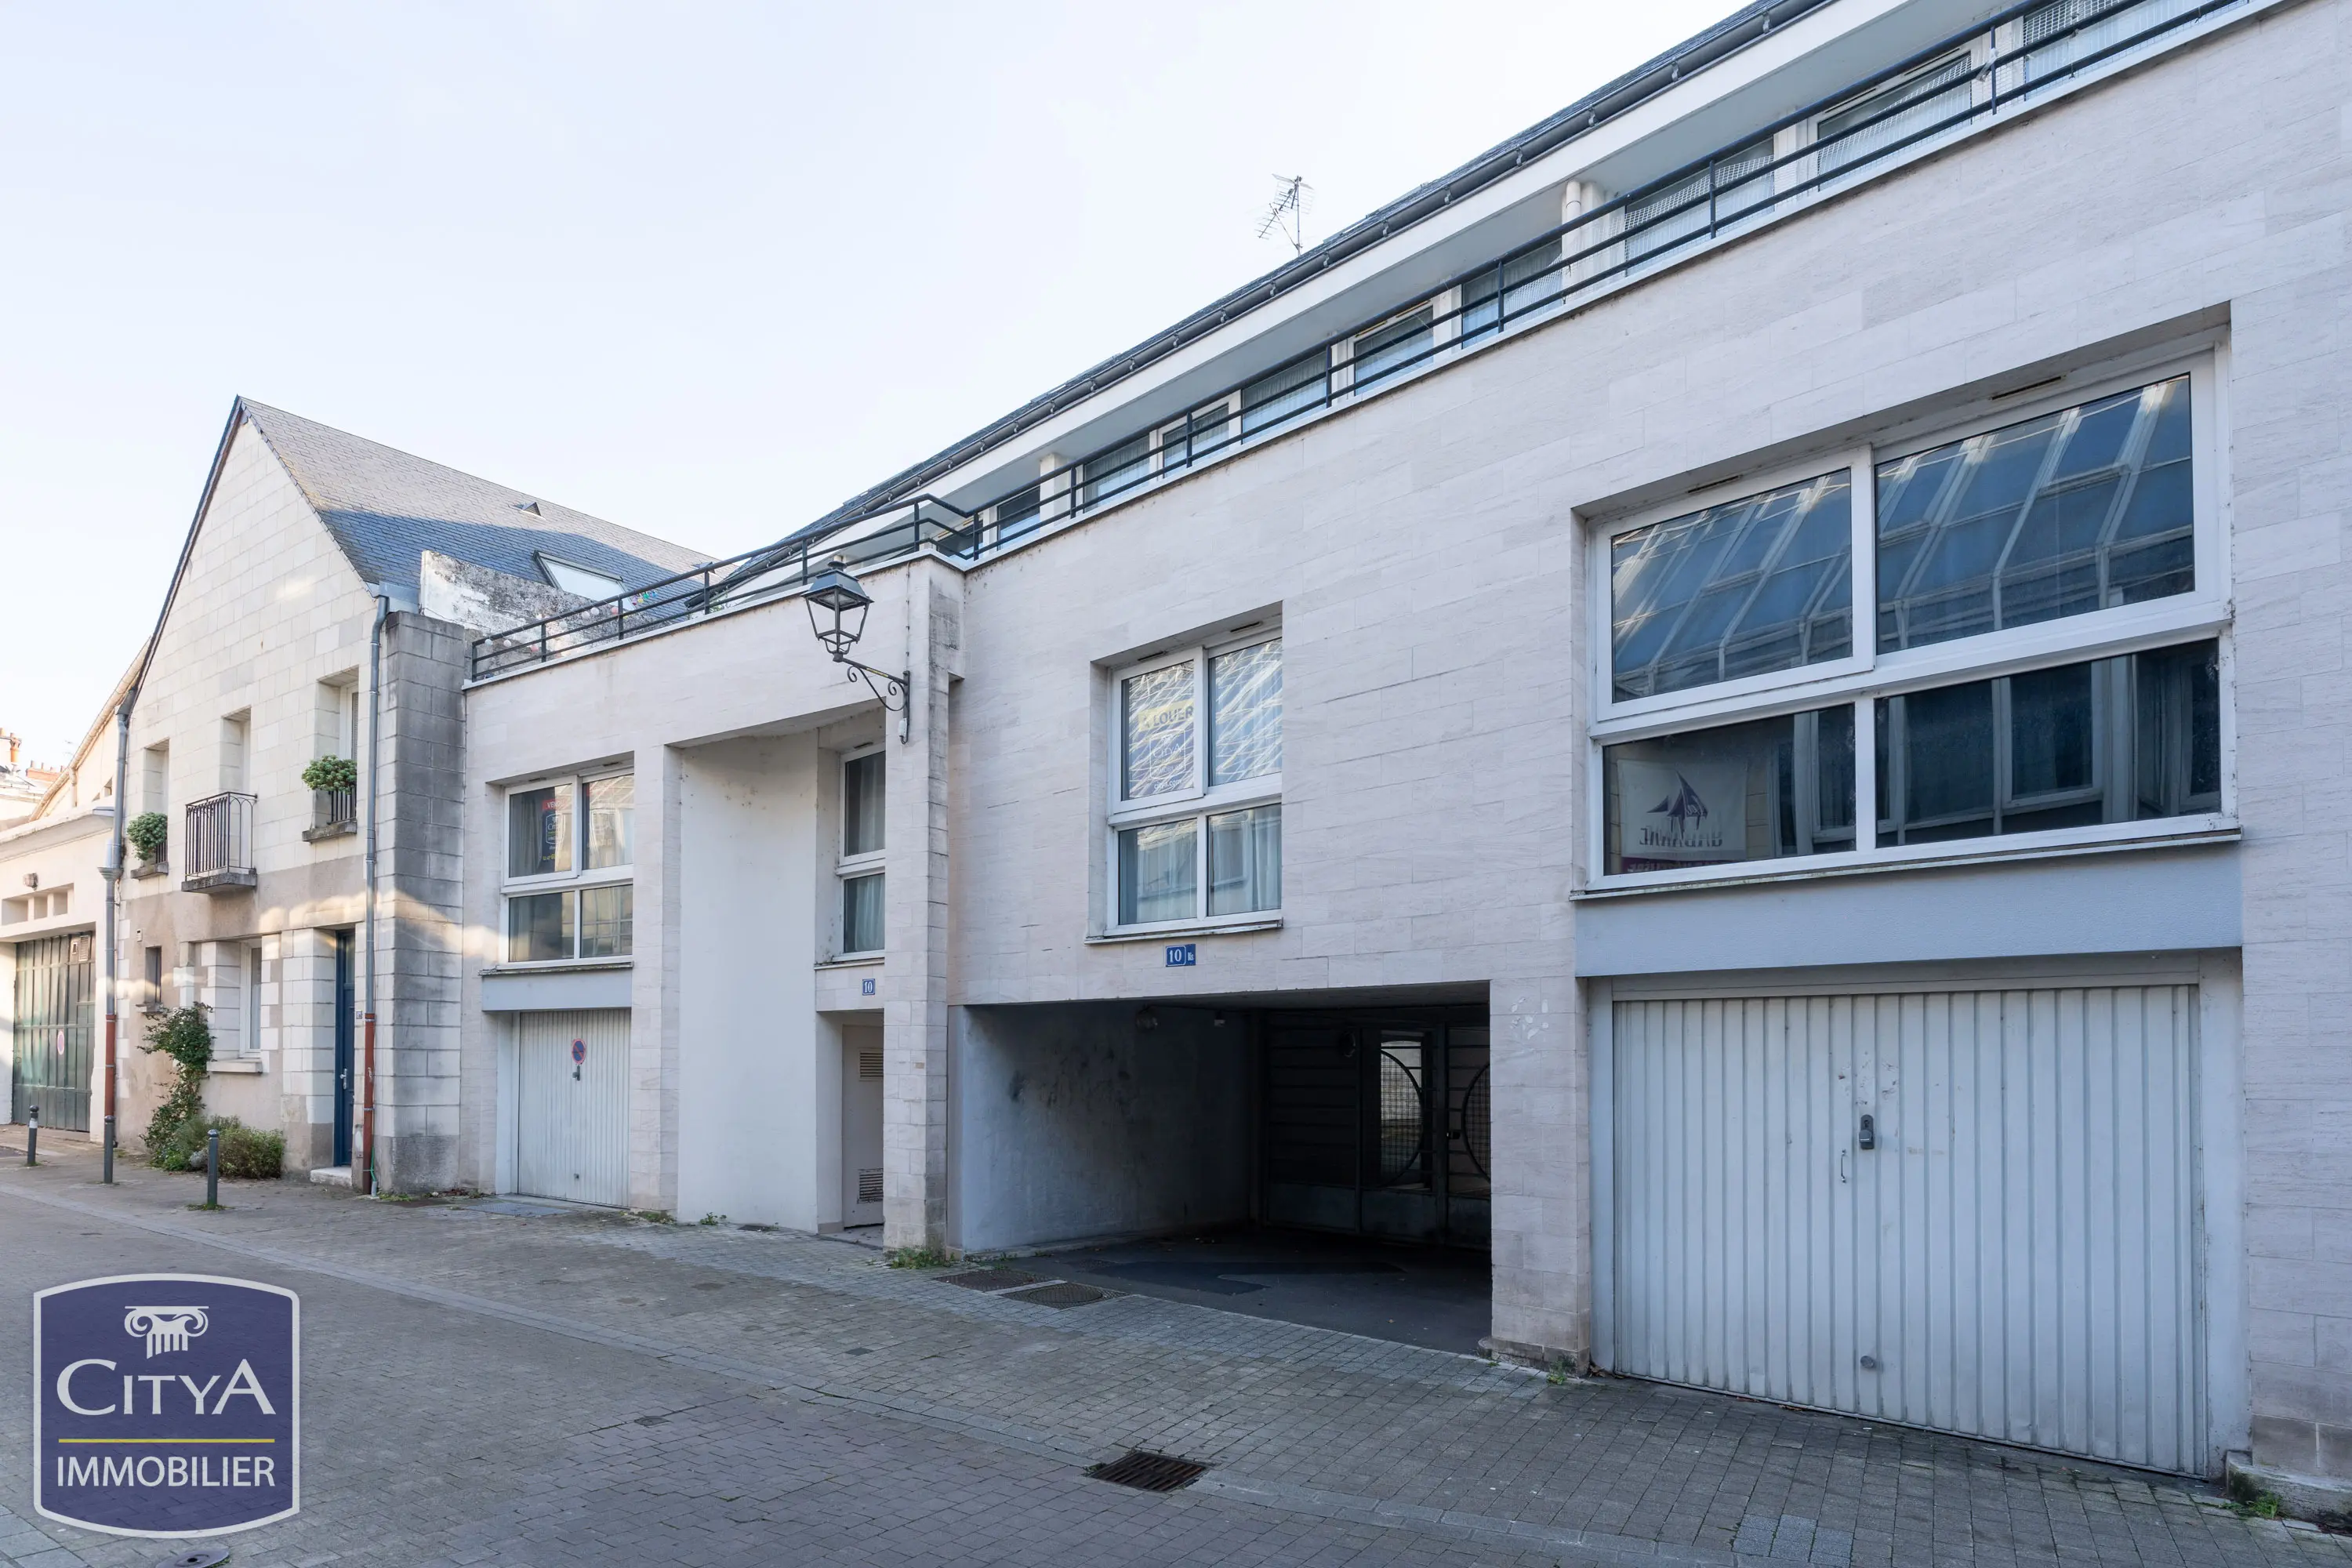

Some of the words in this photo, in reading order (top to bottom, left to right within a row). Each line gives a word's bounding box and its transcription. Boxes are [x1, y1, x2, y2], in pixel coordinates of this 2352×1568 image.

[1153, 706, 1194, 727] LOUER
[1169, 949, 1182, 964] 10
[864, 981, 873, 993] 10
